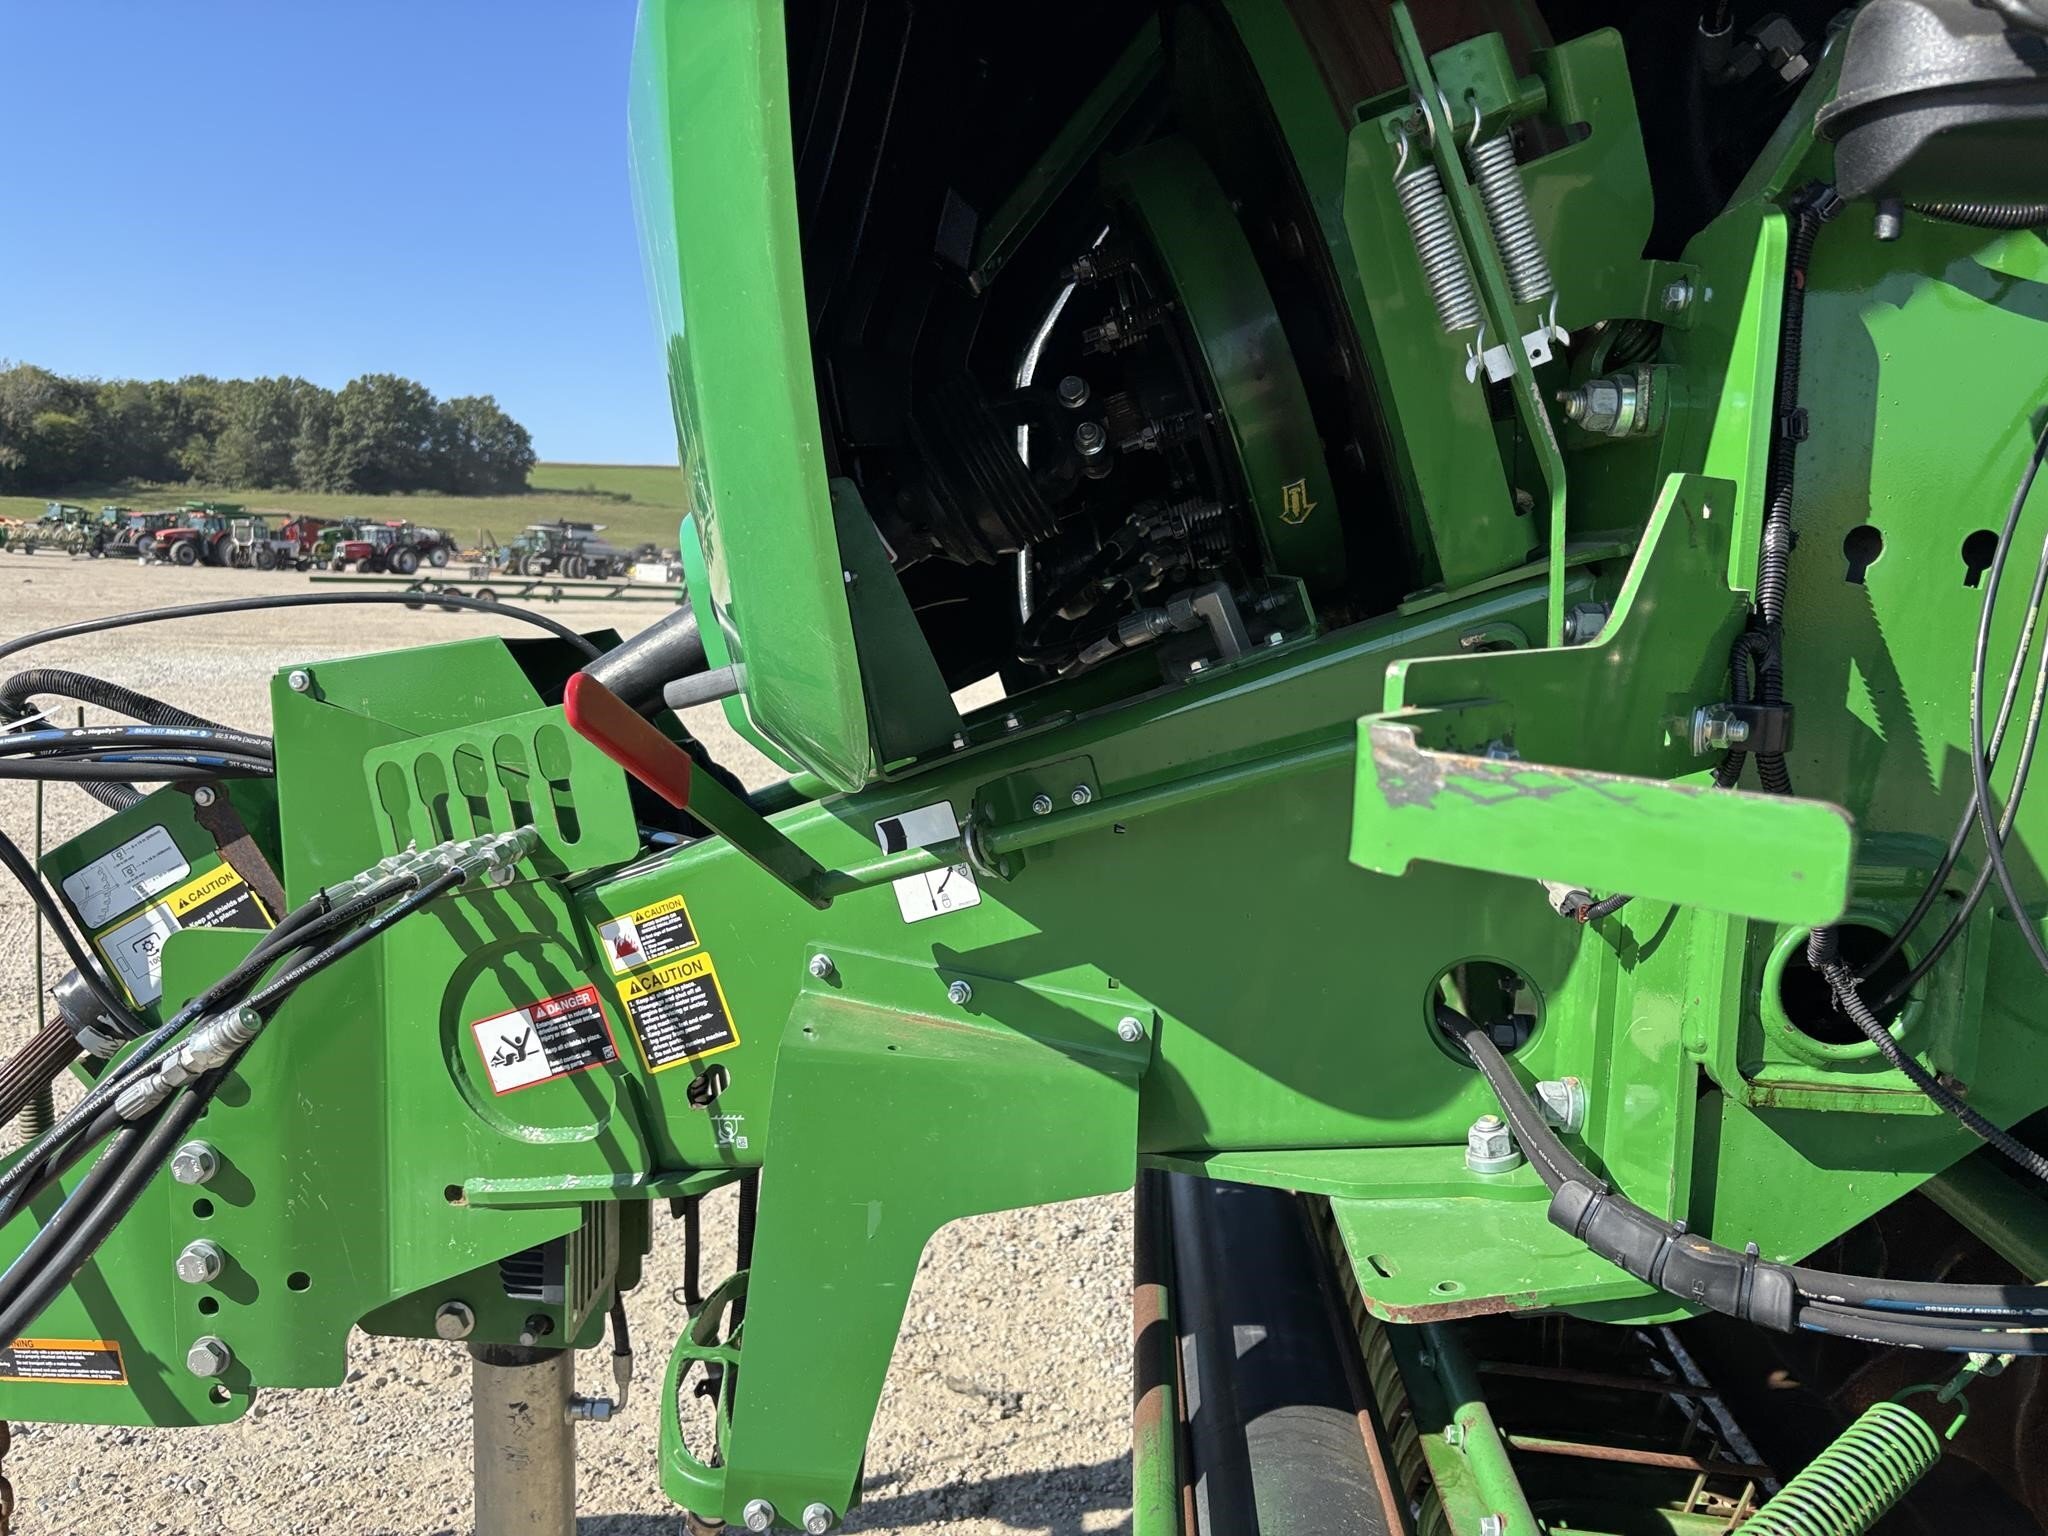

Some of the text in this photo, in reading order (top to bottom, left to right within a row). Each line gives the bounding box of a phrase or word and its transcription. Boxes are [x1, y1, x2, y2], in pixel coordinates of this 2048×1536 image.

[186, 871, 234, 902] CAUTION
[188, 915, 207, 930] Keep
[205, 910, 215, 920] all
[213, 898, 238, 915] shields
[236, 891, 249, 903] and
[643, 898, 682, 918] CAUTION
[639, 959, 703, 990] CAUTION
[545, 992, 591, 1015] DANGER
[12, 1340, 34, 1348] NING
